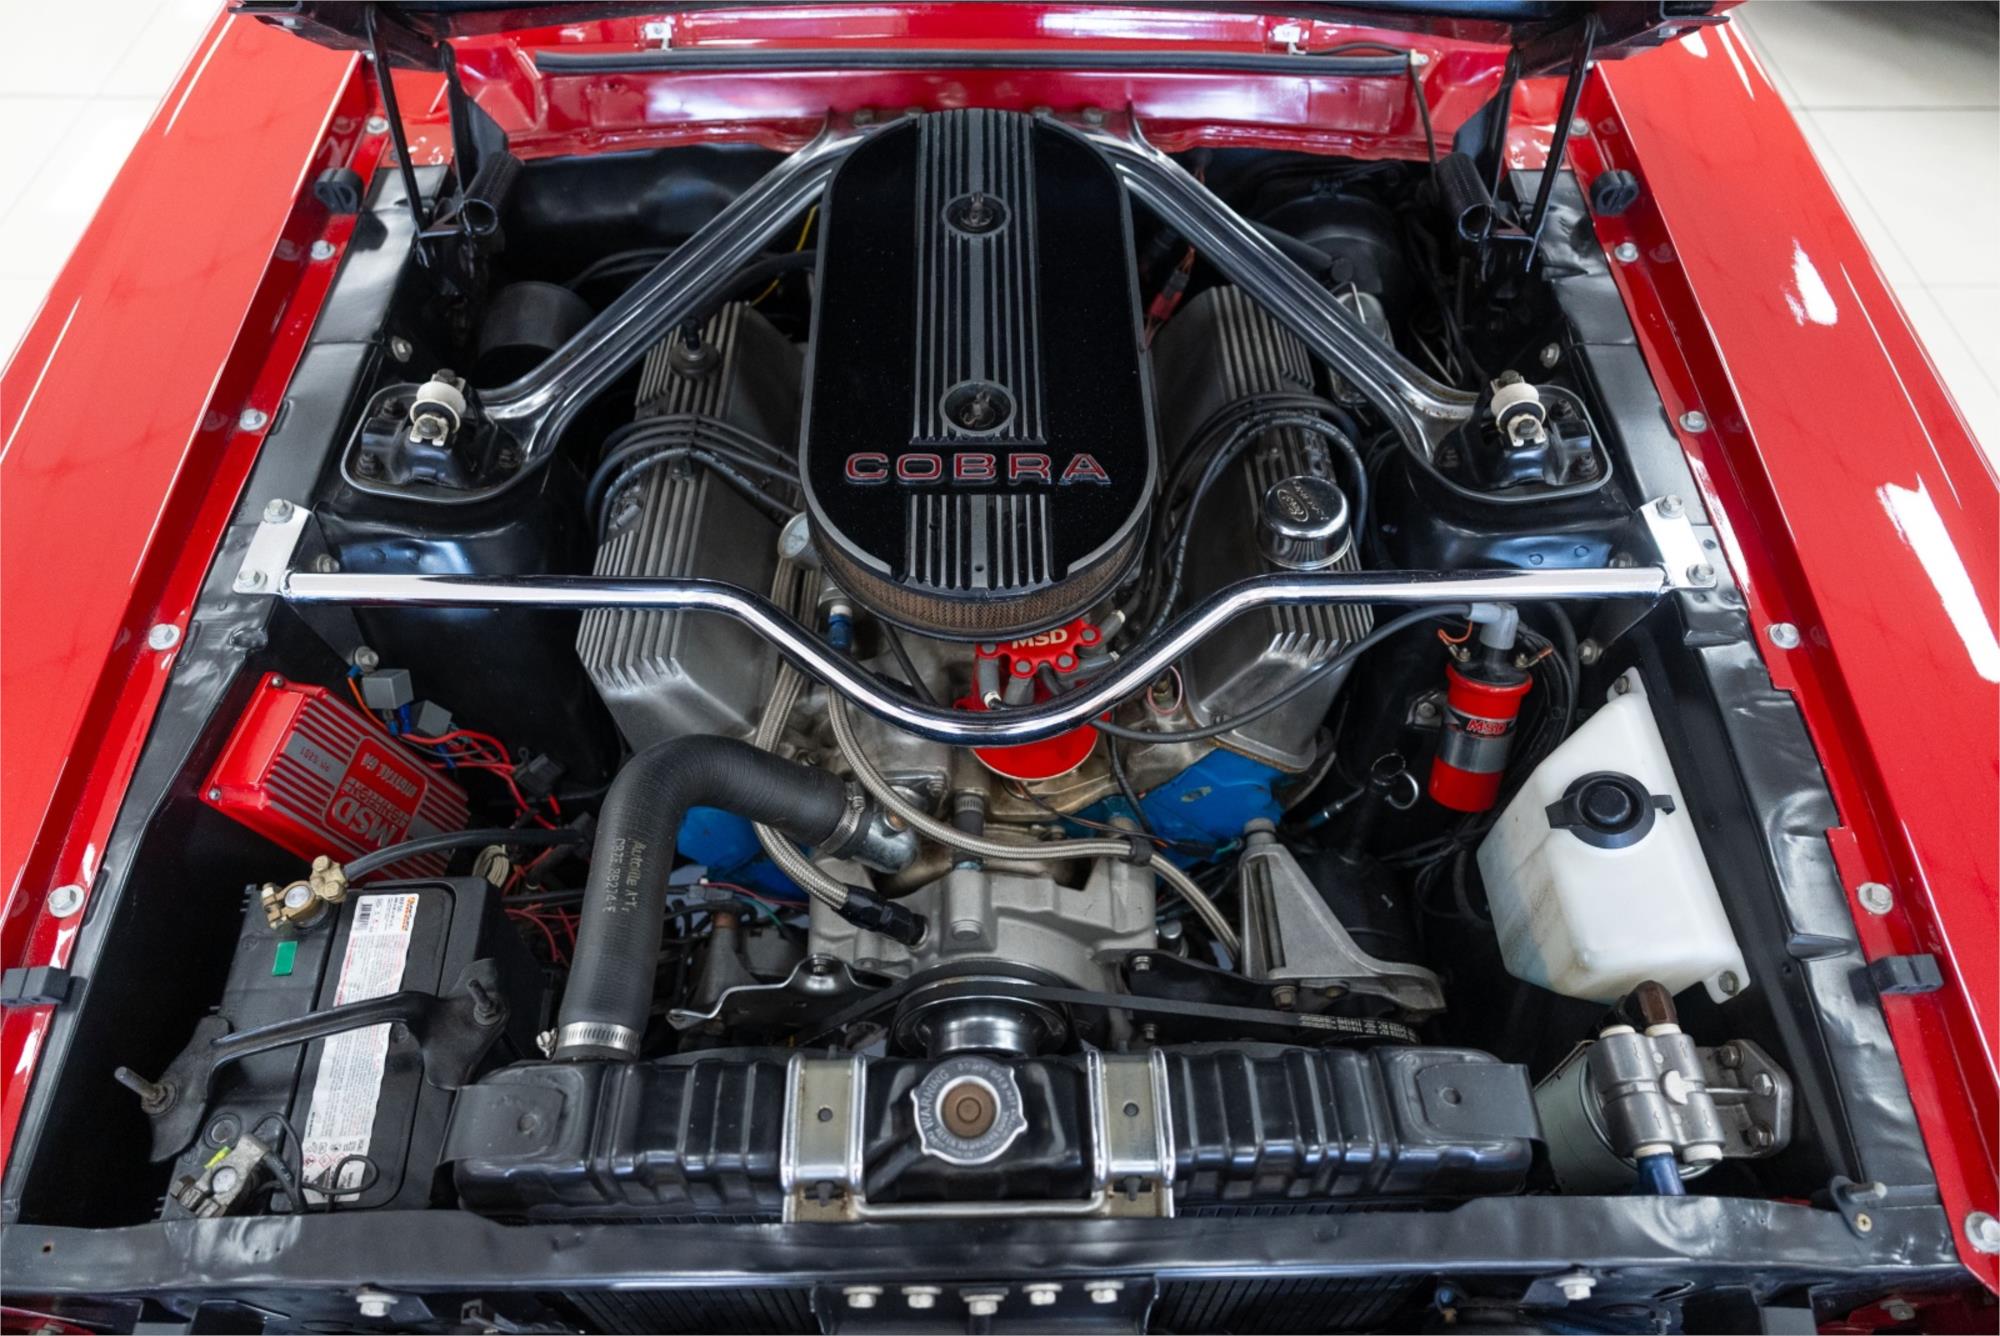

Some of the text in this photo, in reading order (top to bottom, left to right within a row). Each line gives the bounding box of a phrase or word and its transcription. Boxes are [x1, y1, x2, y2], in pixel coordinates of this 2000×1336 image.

[845, 452, 1112, 486] COBRA
[1011, 628, 1069, 650] MSD
[1465, 718, 1508, 736] MSD
[377, 763, 418, 799] DIGITAL
[332, 796, 399, 848] MSD
[919, 1069, 950, 1131] WARNING
